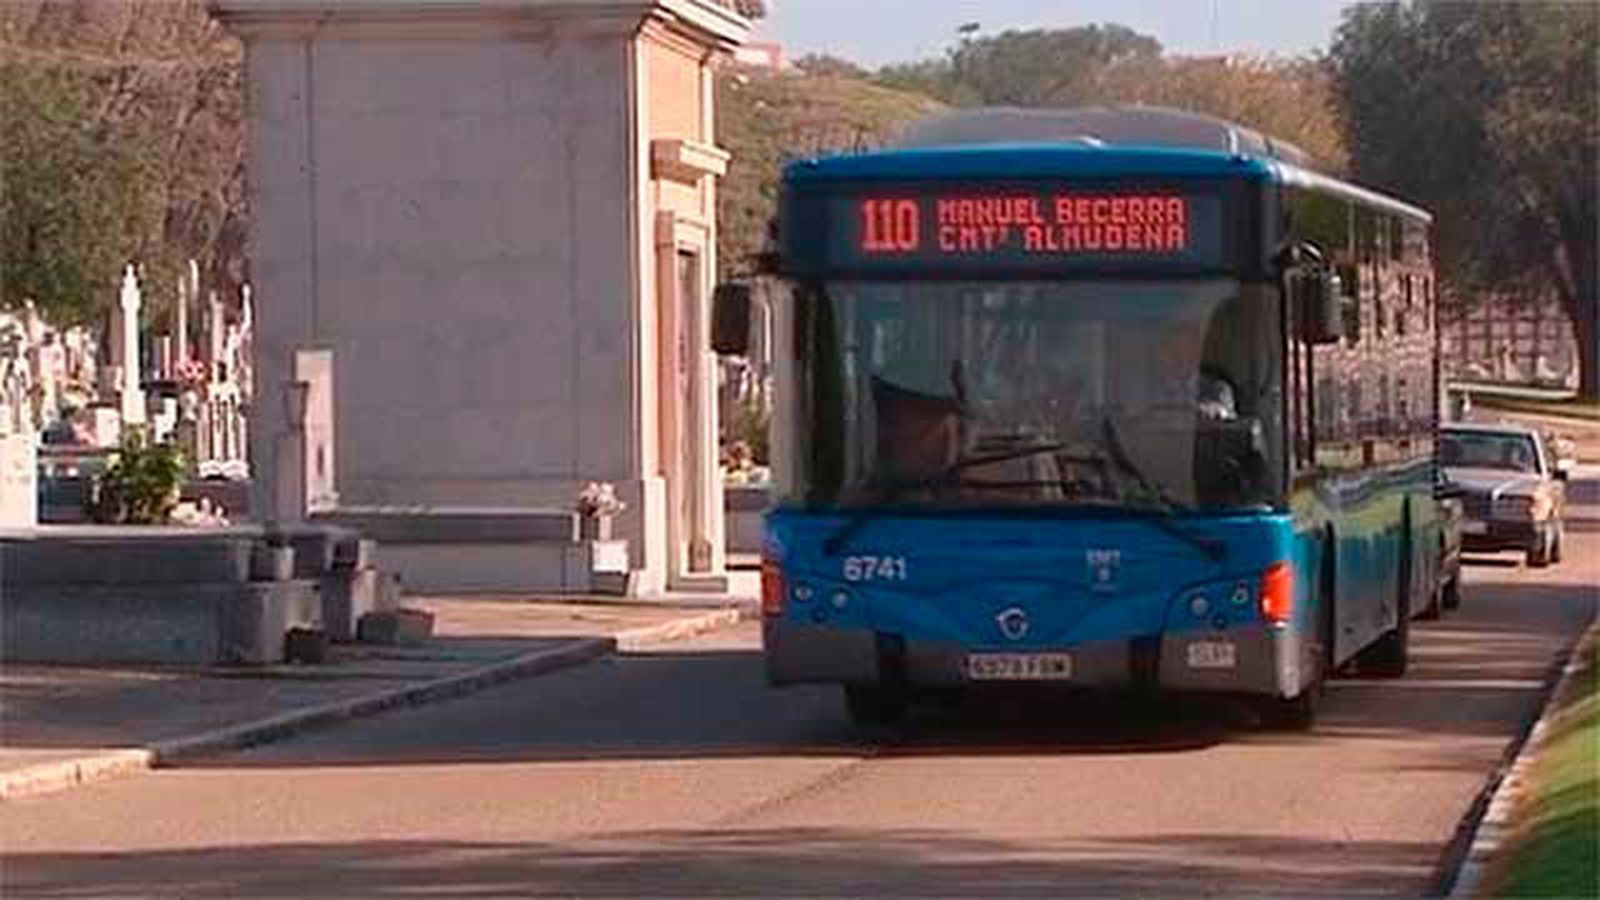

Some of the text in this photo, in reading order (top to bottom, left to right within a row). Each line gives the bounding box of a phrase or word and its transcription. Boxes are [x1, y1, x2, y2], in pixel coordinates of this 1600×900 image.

[938, 198, 1184, 224] MANUEL BECERRA
[861, 199, 918, 250] 110
[1024, 226, 1185, 250] ALMUDENA
[844, 556, 907, 580] 6741
